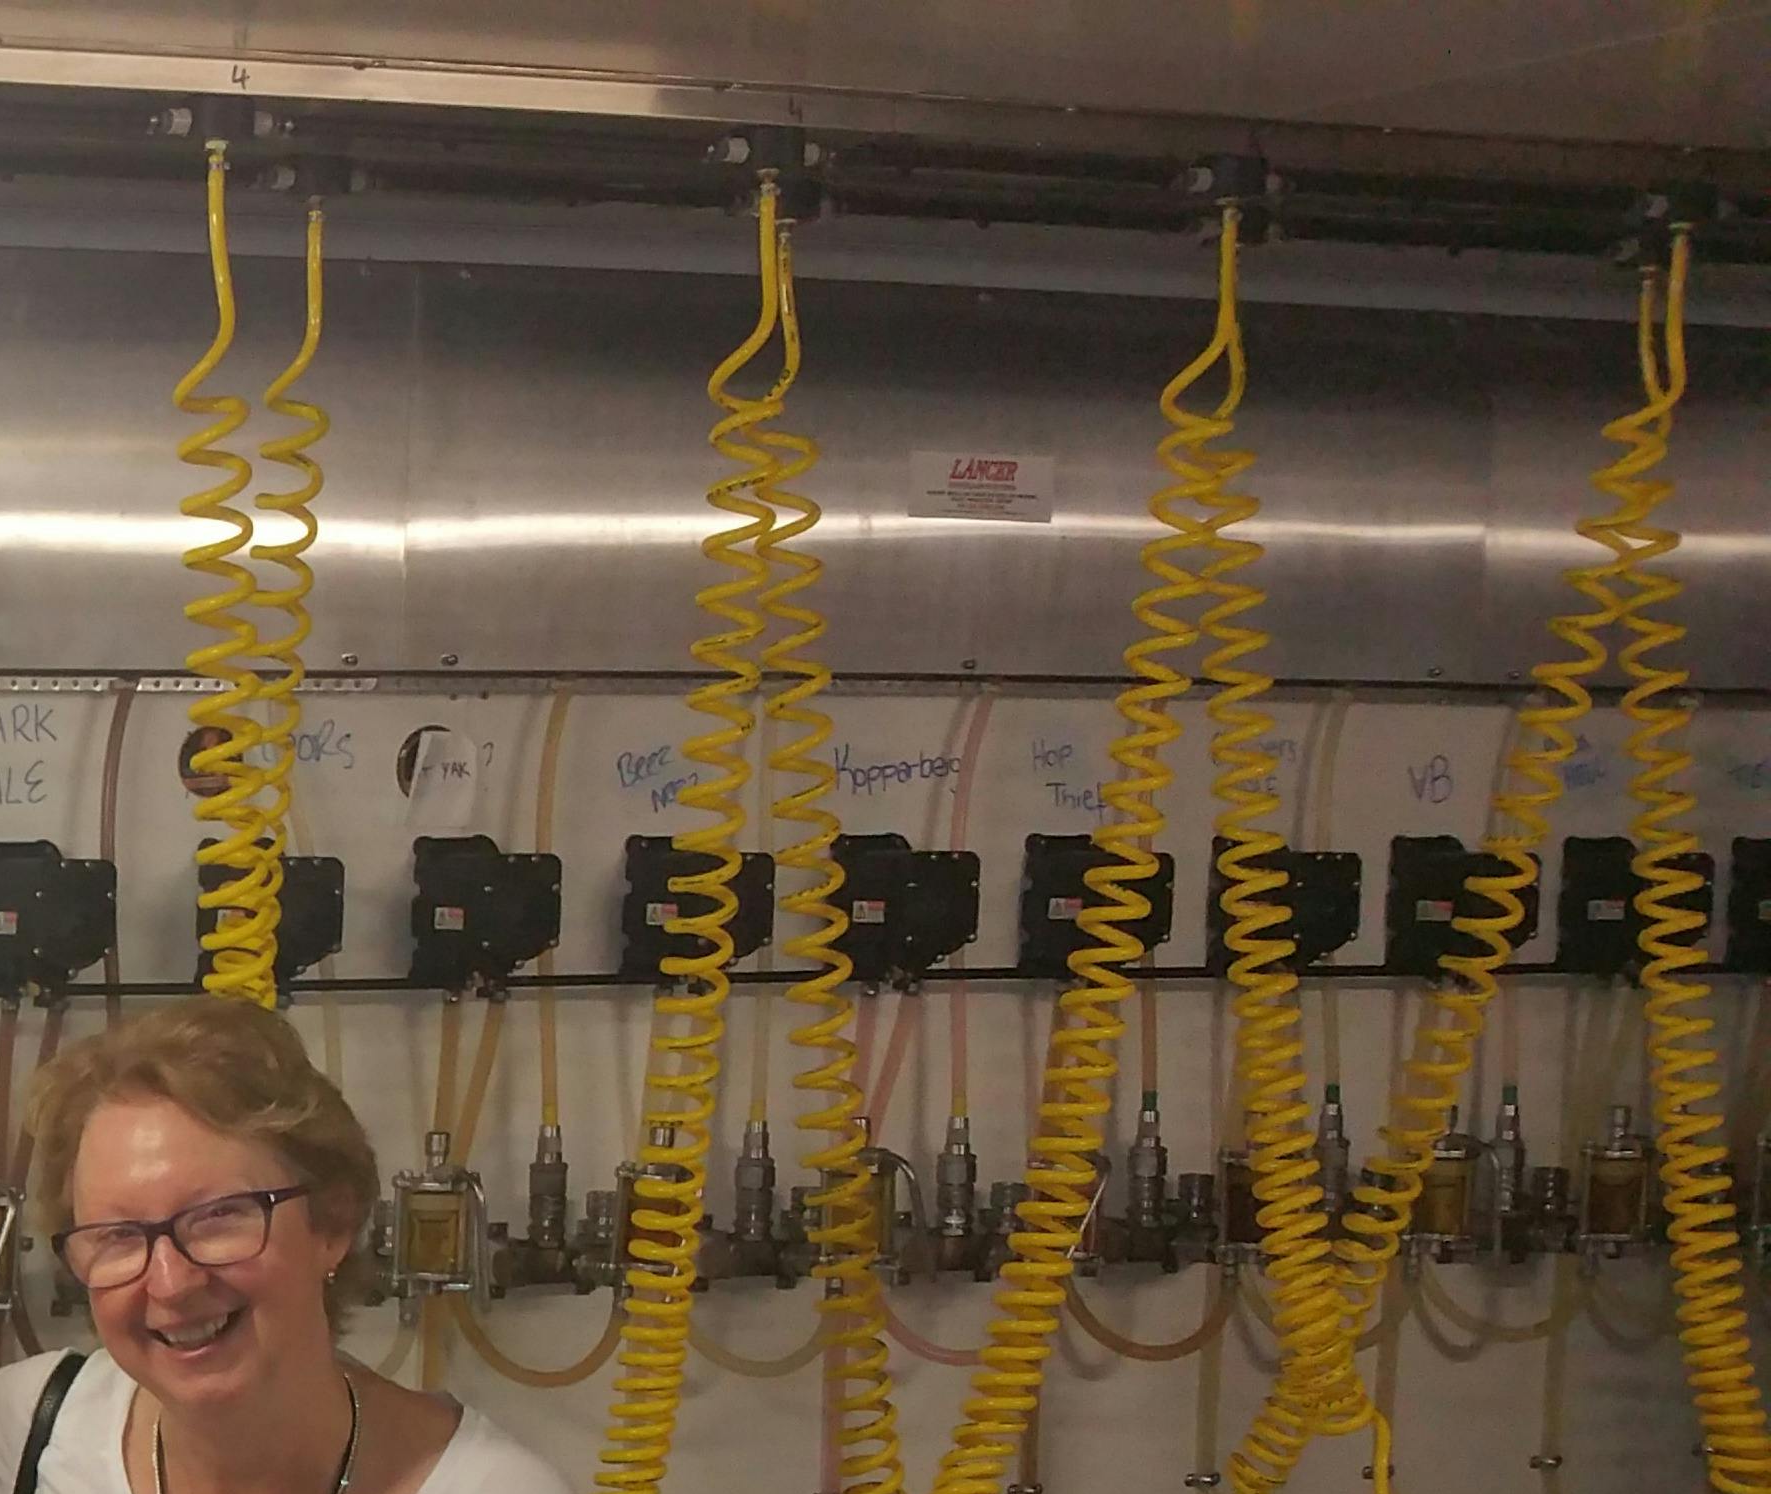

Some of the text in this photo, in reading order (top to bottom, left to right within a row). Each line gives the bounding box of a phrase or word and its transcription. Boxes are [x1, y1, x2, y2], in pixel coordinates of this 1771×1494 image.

[231, 64, 250, 90] 4
[949, 457, 1018, 482] LANCER
[1407, 754, 1454, 804] VB
